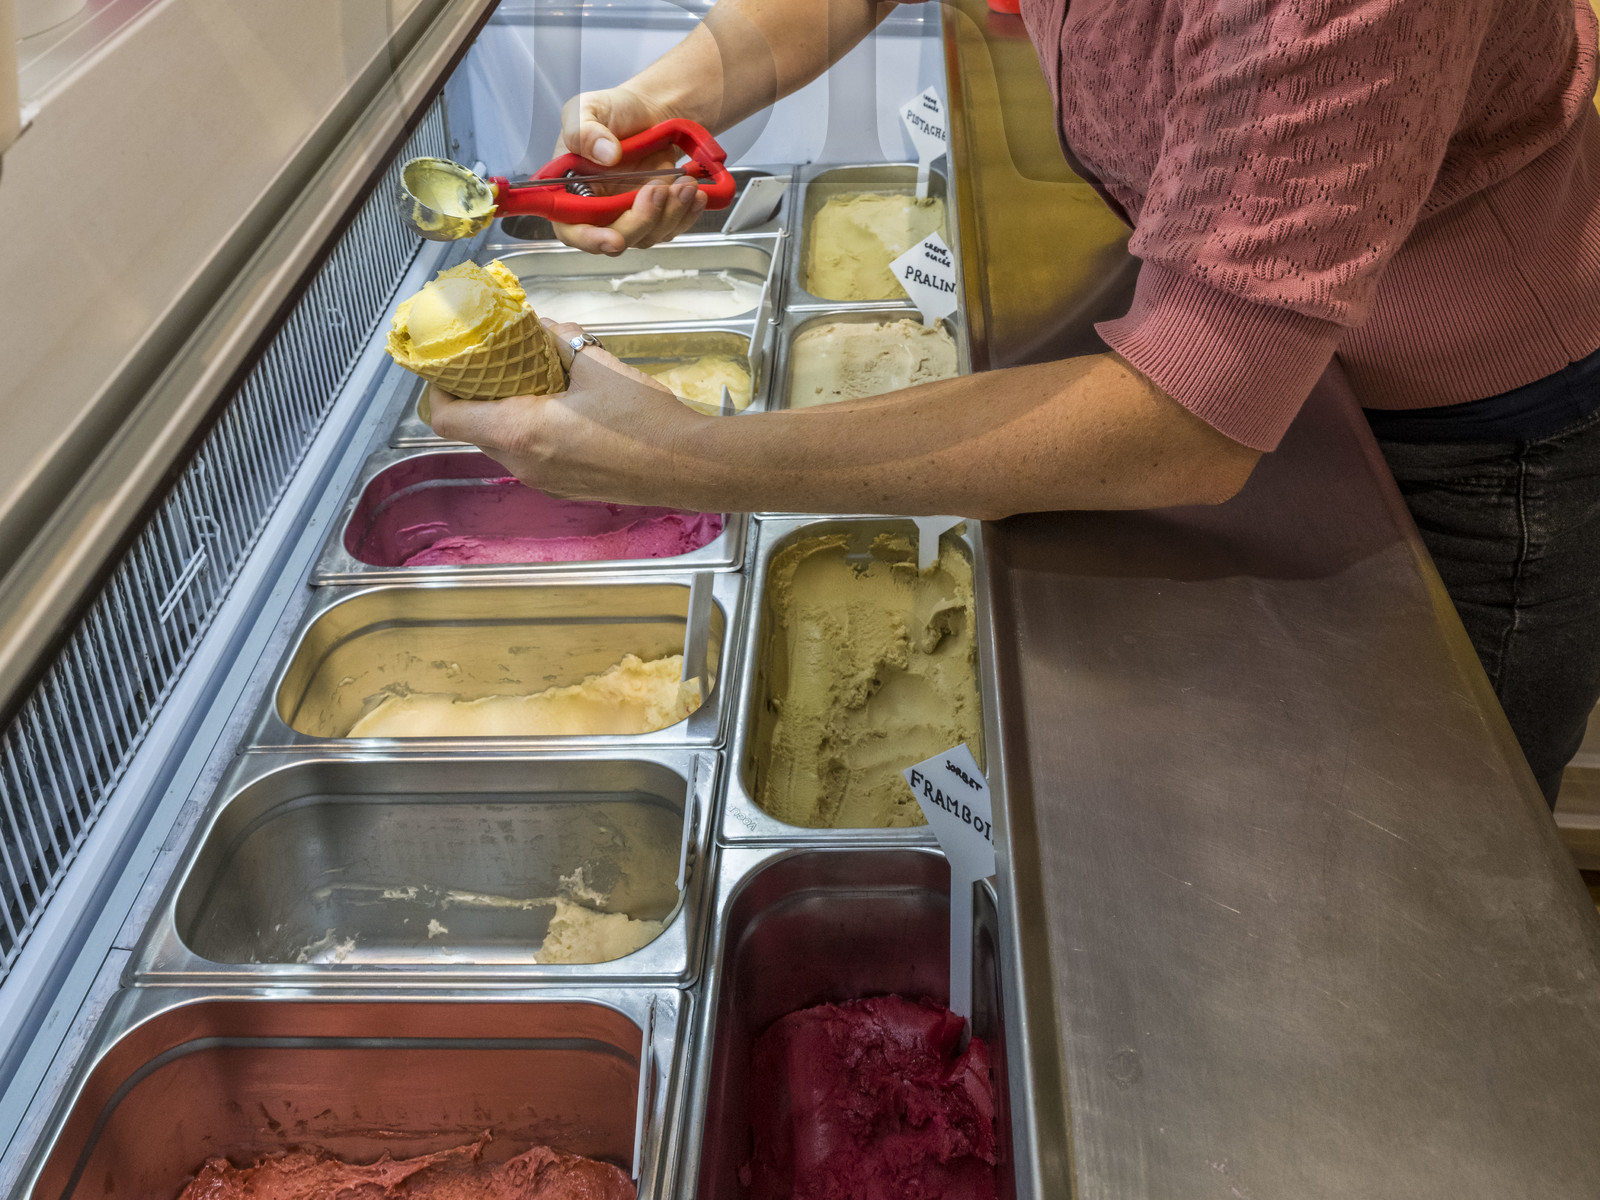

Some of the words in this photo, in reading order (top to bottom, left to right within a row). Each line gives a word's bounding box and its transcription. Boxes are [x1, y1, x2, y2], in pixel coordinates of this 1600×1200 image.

[906, 109, 947, 142] PISTACHE
[904, 265, 957, 295] PRALIN
[945, 760, 983, 792] SORBET
[910, 768, 995, 846] FRAMBOI
